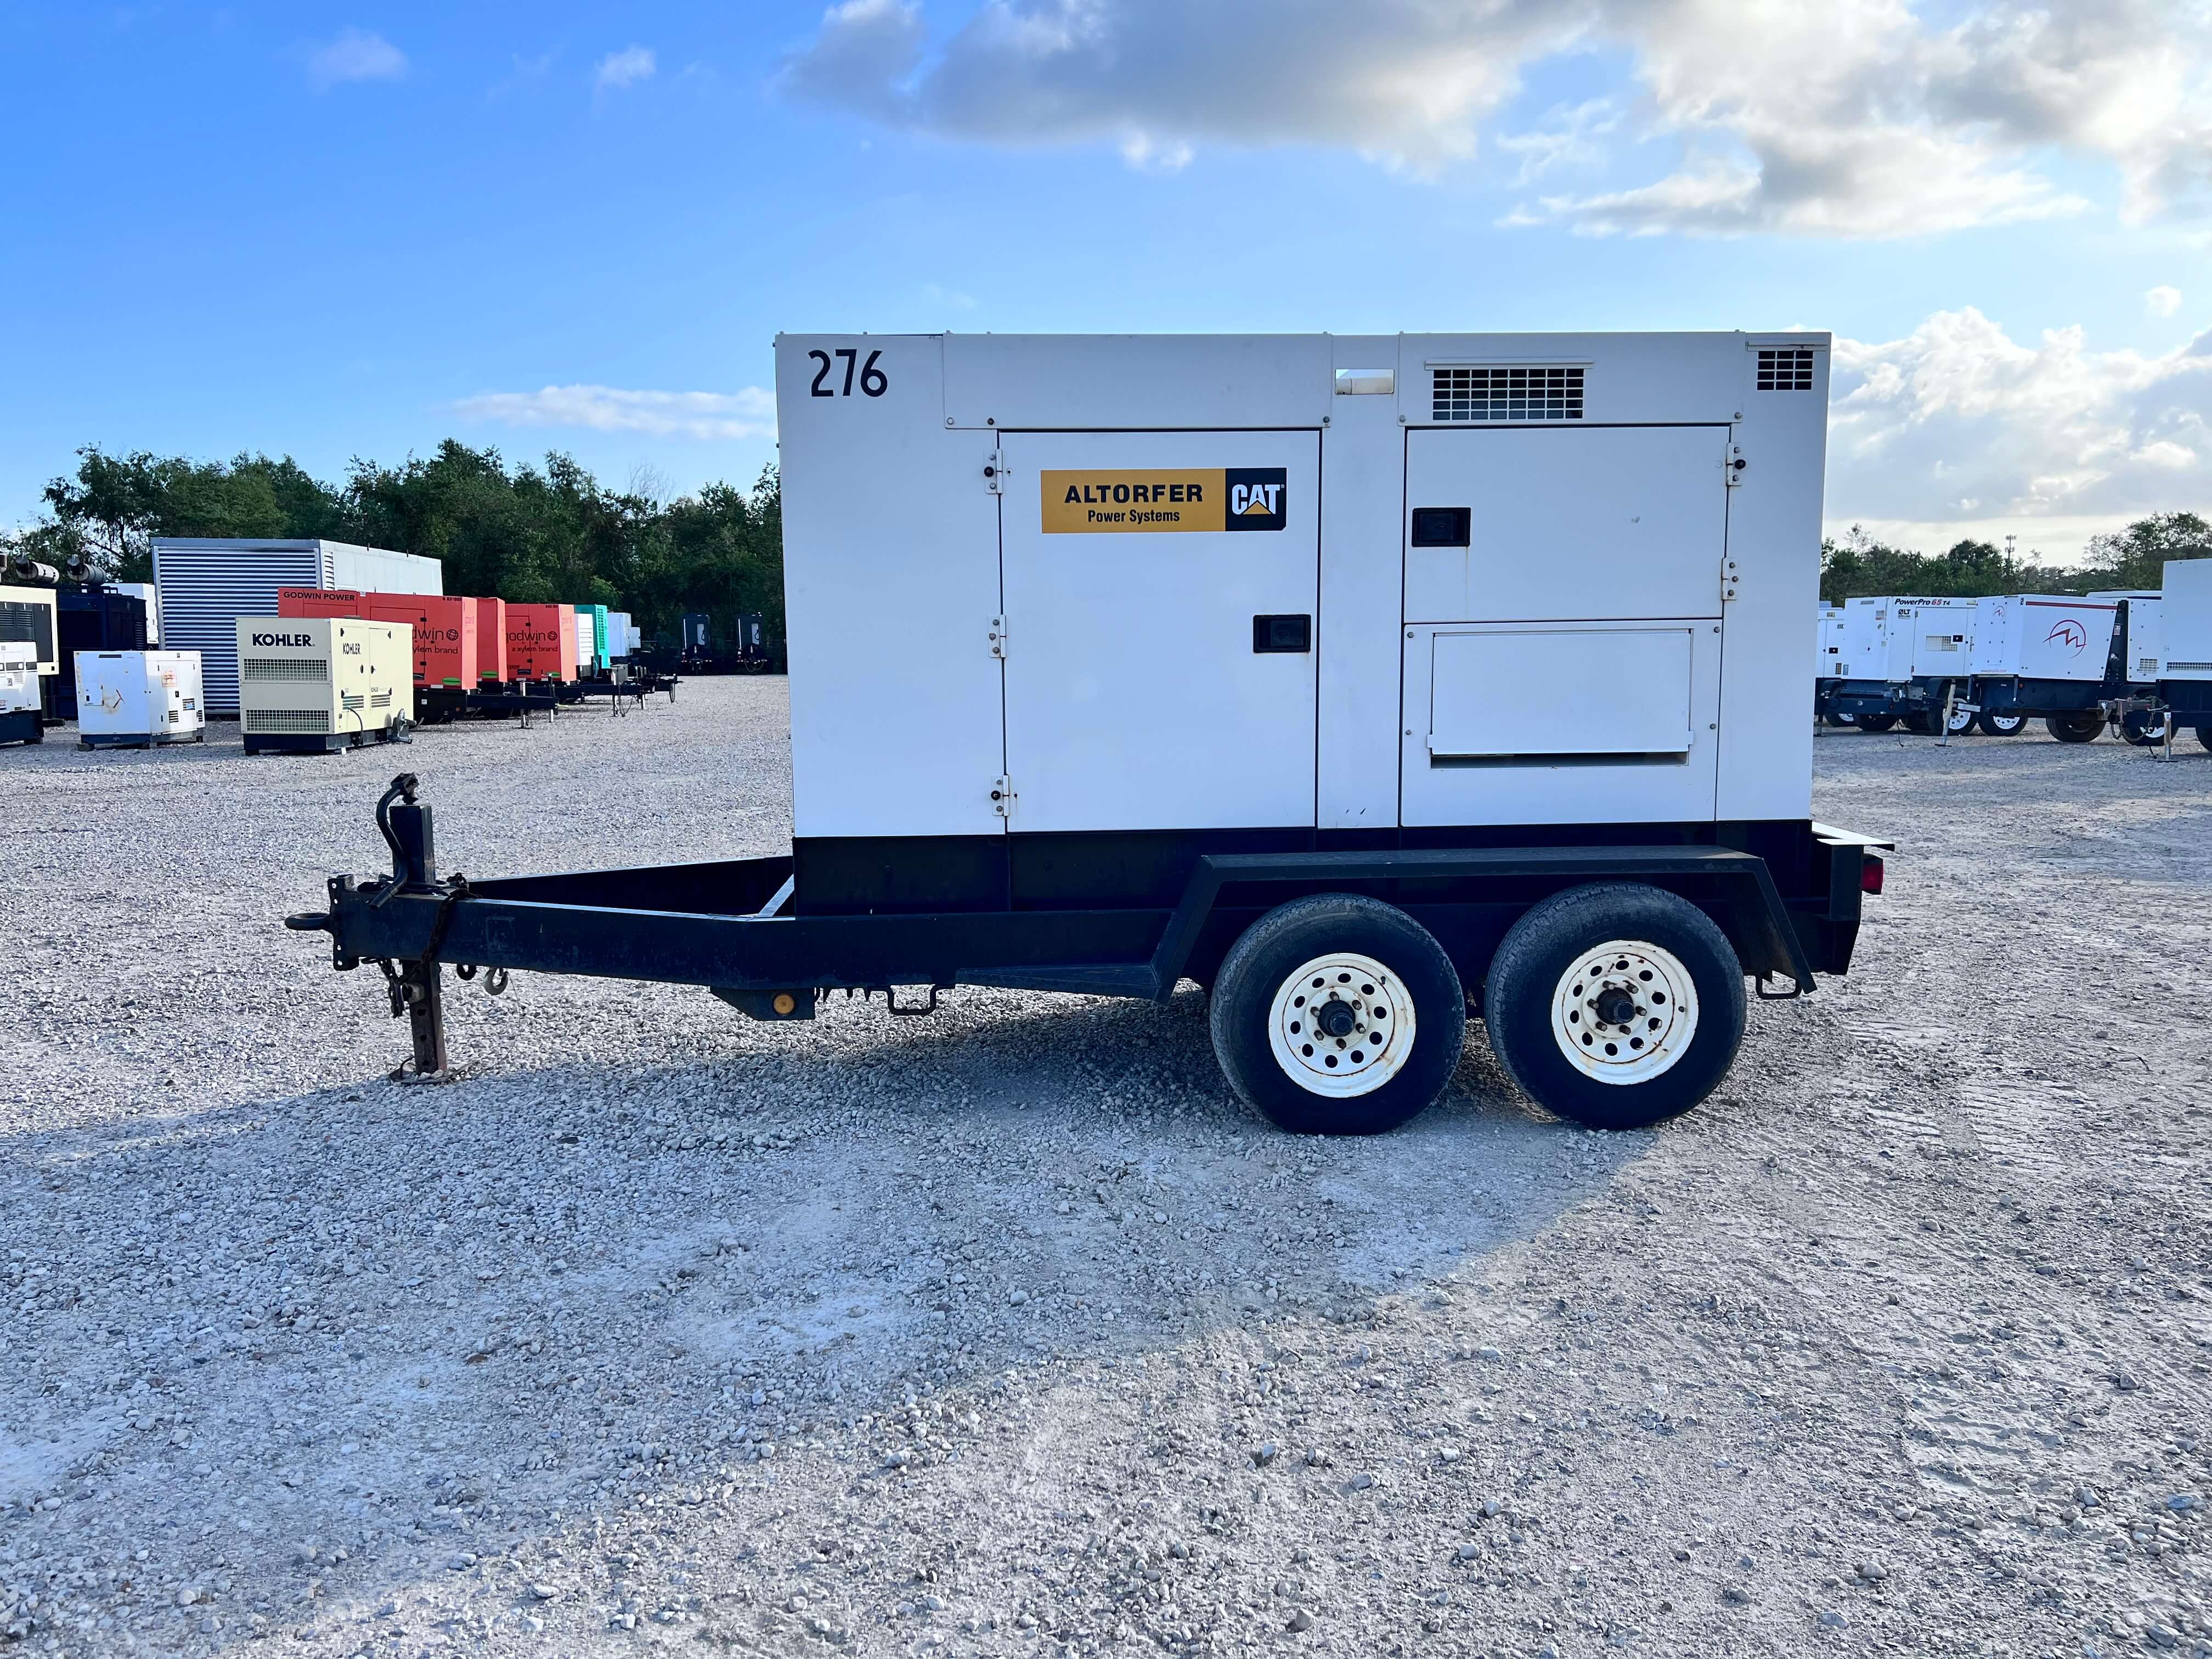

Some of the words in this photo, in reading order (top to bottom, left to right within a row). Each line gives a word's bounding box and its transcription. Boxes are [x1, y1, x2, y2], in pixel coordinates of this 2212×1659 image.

[808, 349, 888, 397] 276
[1064, 484, 1203, 503] ALTORFER
[1232, 484, 1280, 515] CAT
[1088, 510, 1126, 522] Power
[1130, 509, 1180, 524] Systems
[412, 625, 444, 640] dwin
[252, 634, 313, 647] KOHLER
[343, 643, 360, 654] KOHLER
[413, 645, 432, 654] ylem
[435, 646, 458, 654] brand
